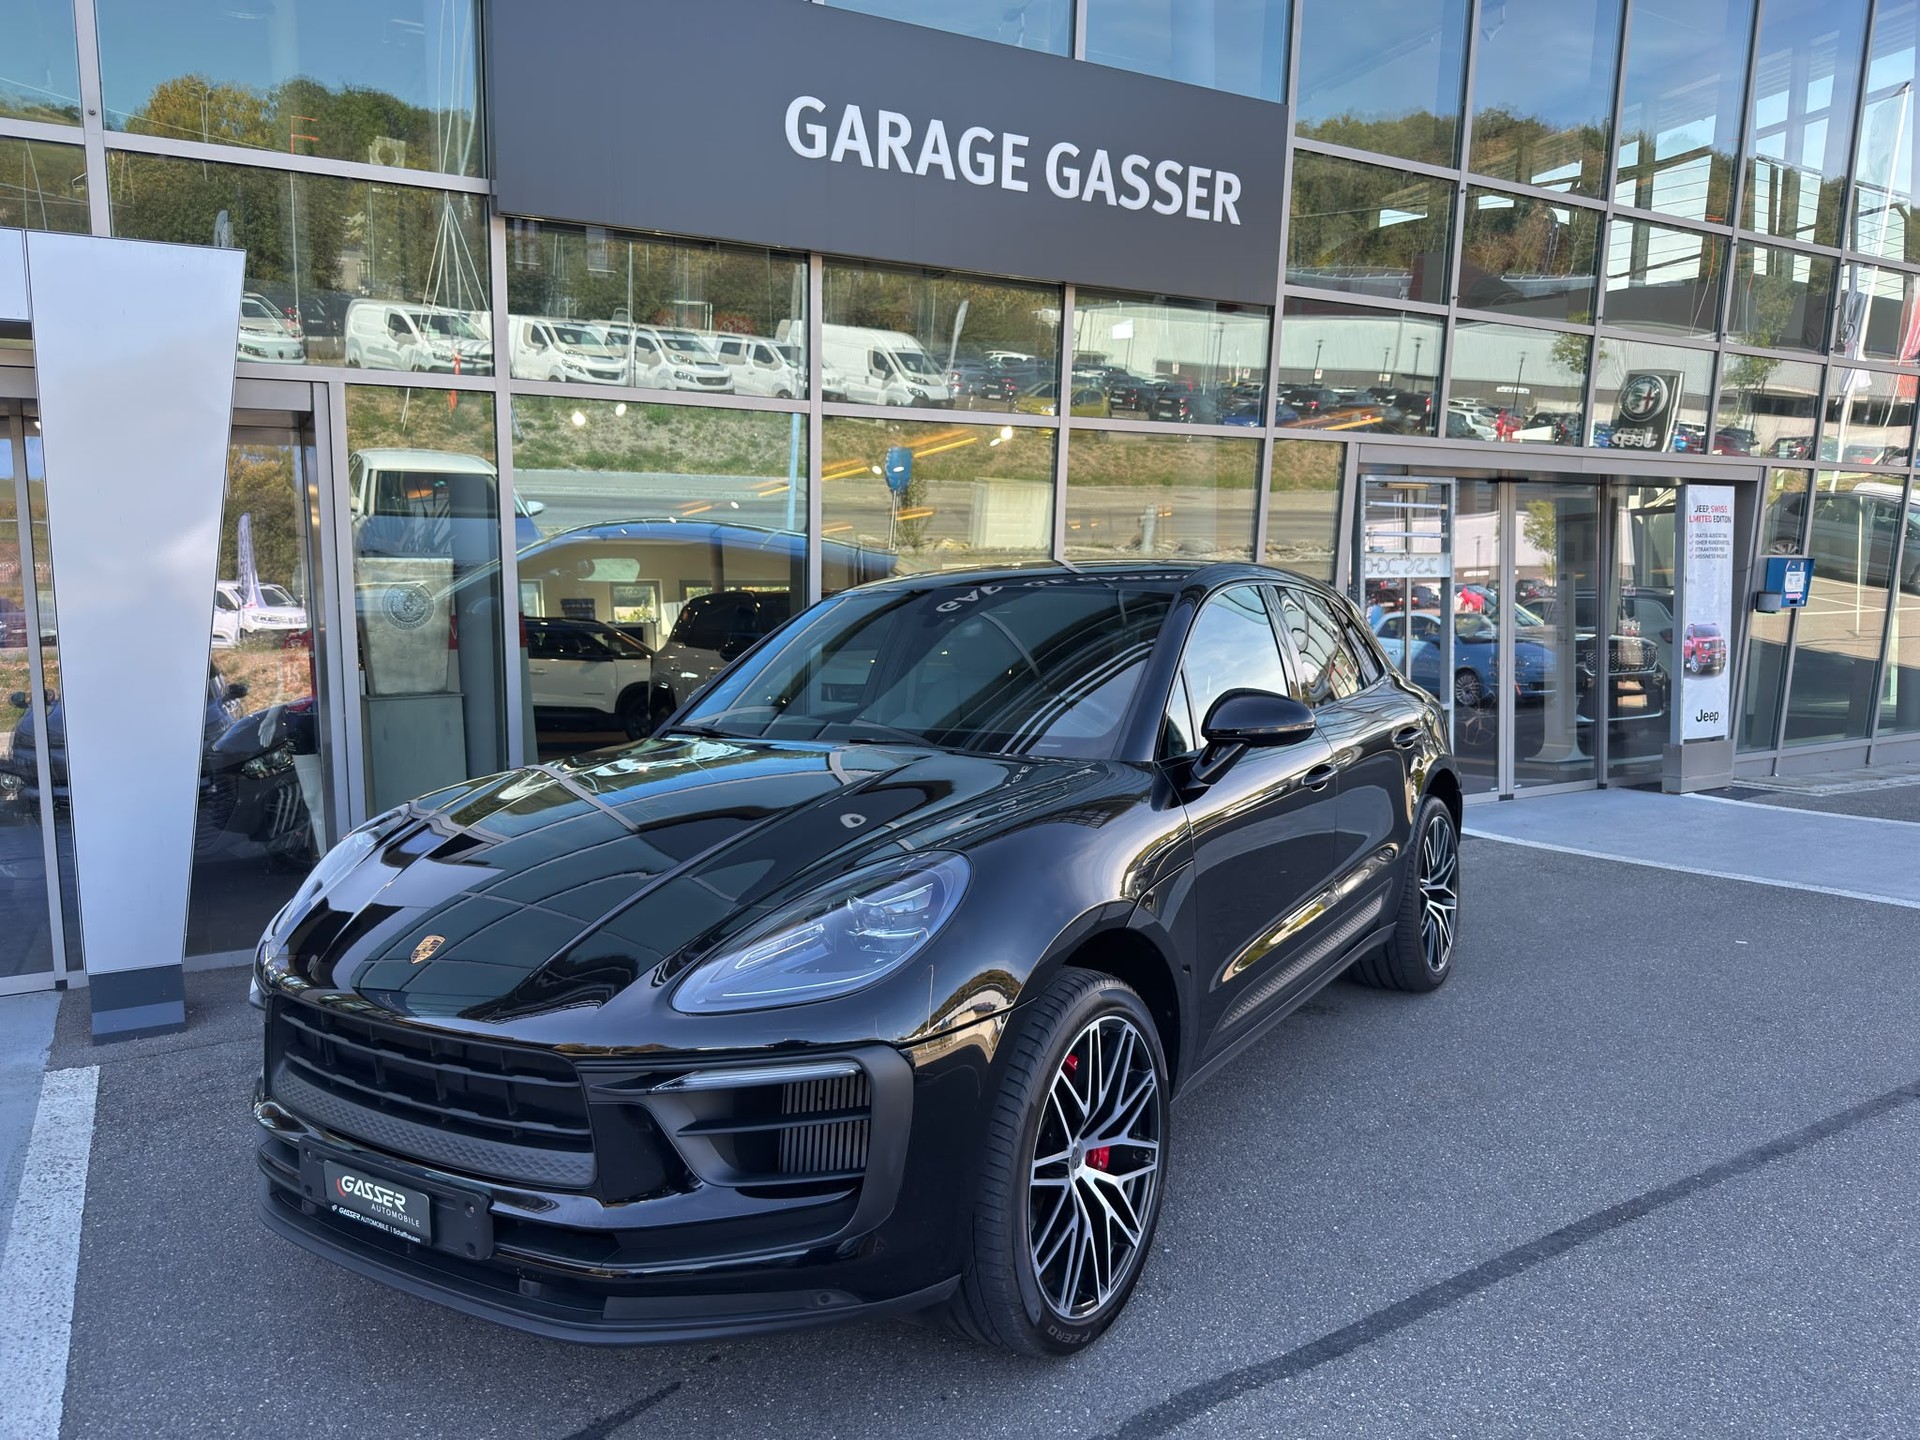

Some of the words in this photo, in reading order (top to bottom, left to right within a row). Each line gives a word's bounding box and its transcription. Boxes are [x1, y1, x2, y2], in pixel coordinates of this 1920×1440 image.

[785, 96, 1029, 192] GARAGE
[1045, 142, 1242, 225] GASSER
[1695, 709, 1719, 723] Jeep
[341, 1175, 406, 1213] GASSER
[339, 1206, 361, 1220] GASSER
[360, 1215, 390, 1232] AUTOMOBILE
[371, 1203, 420, 1227] AUTOMOBILE
[1047, 1324, 1081, 1344] ZERO
[1081, 1330, 1091, 1342] P
